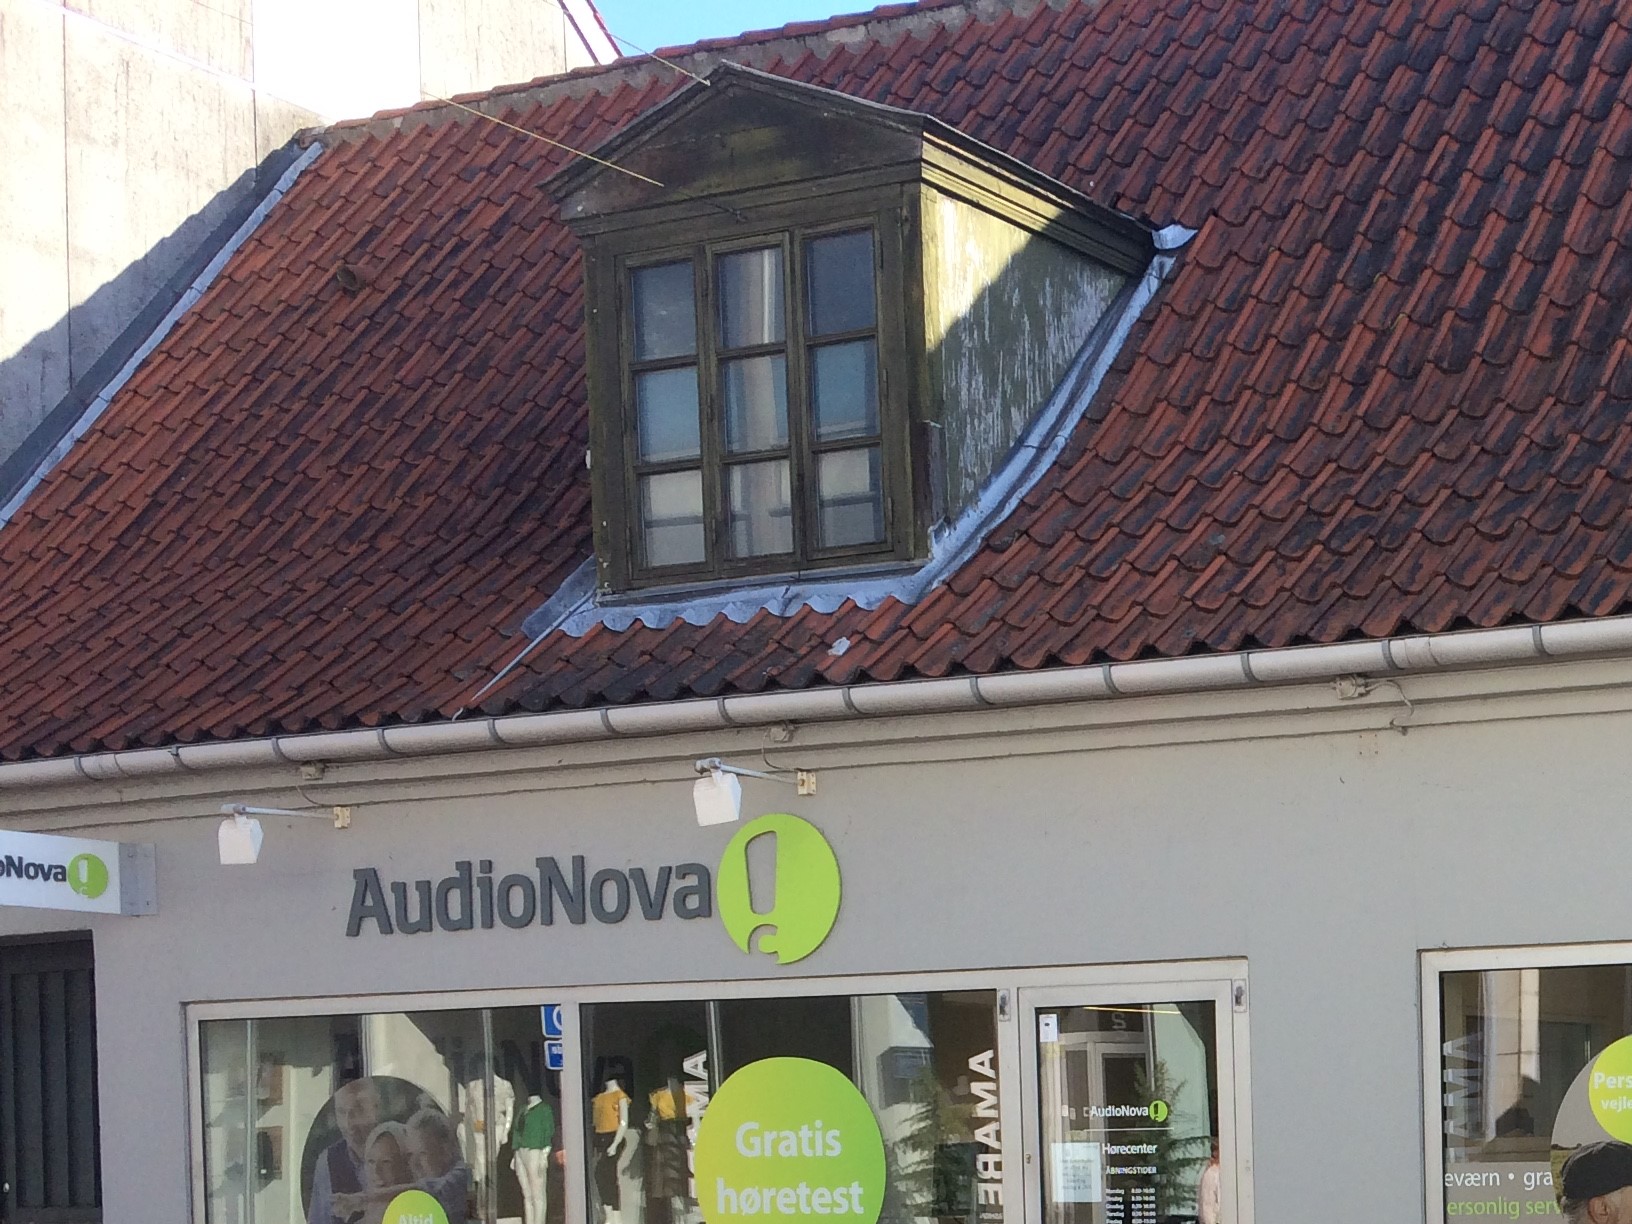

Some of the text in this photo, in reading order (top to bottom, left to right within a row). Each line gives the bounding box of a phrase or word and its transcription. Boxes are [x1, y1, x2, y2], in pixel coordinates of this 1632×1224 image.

[345, 855, 712, 937] AudioNova
[1091, 1105, 1148, 1116] AudioNova
[735, 1120, 842, 1157] Gratis
[1102, 1143, 1158, 1154] Hørecenter
[1445, 1171, 1500, 1187] eværn
[716, 1177, 865, 1215] høretest
[1447, 1197, 1519, 1219] ersonlig
